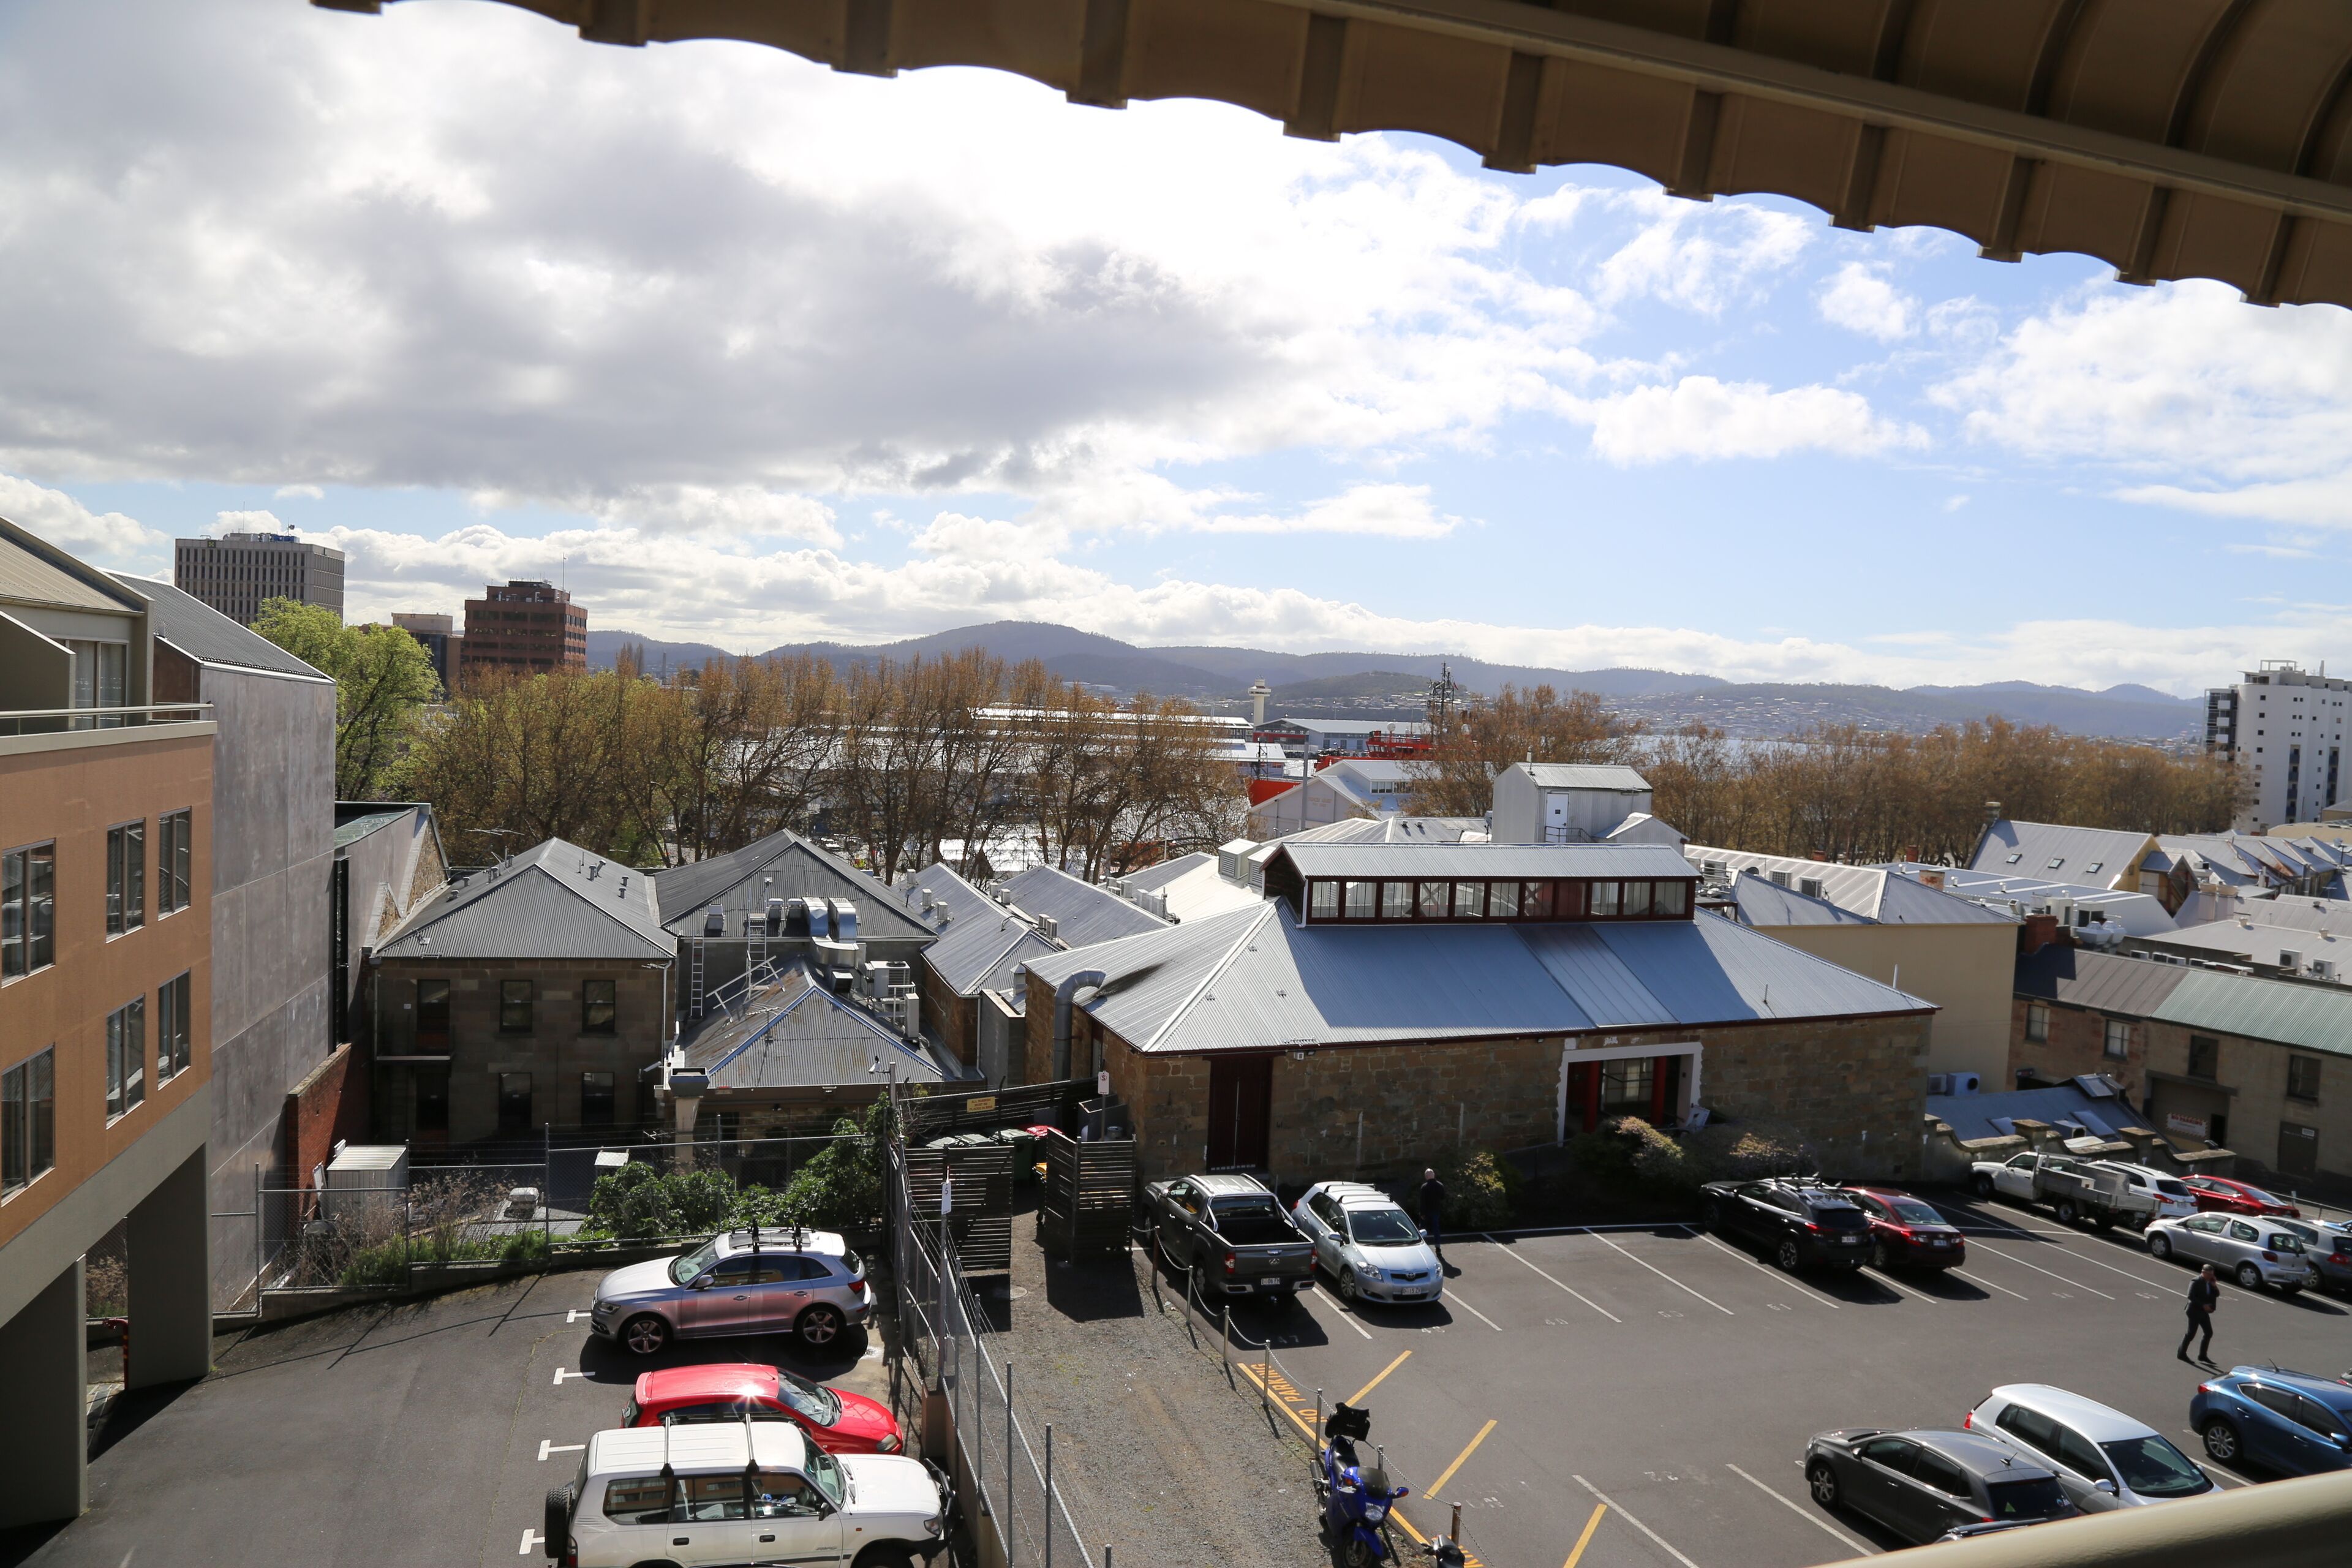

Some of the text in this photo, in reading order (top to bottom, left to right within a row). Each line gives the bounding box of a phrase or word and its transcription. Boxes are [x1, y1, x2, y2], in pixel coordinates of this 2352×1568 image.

[2179, 1117, 2203, 1126] PARKING
[1278, 1335, 1299, 1344] 47
[1250, 1363, 1328, 1423] NO PARKING
